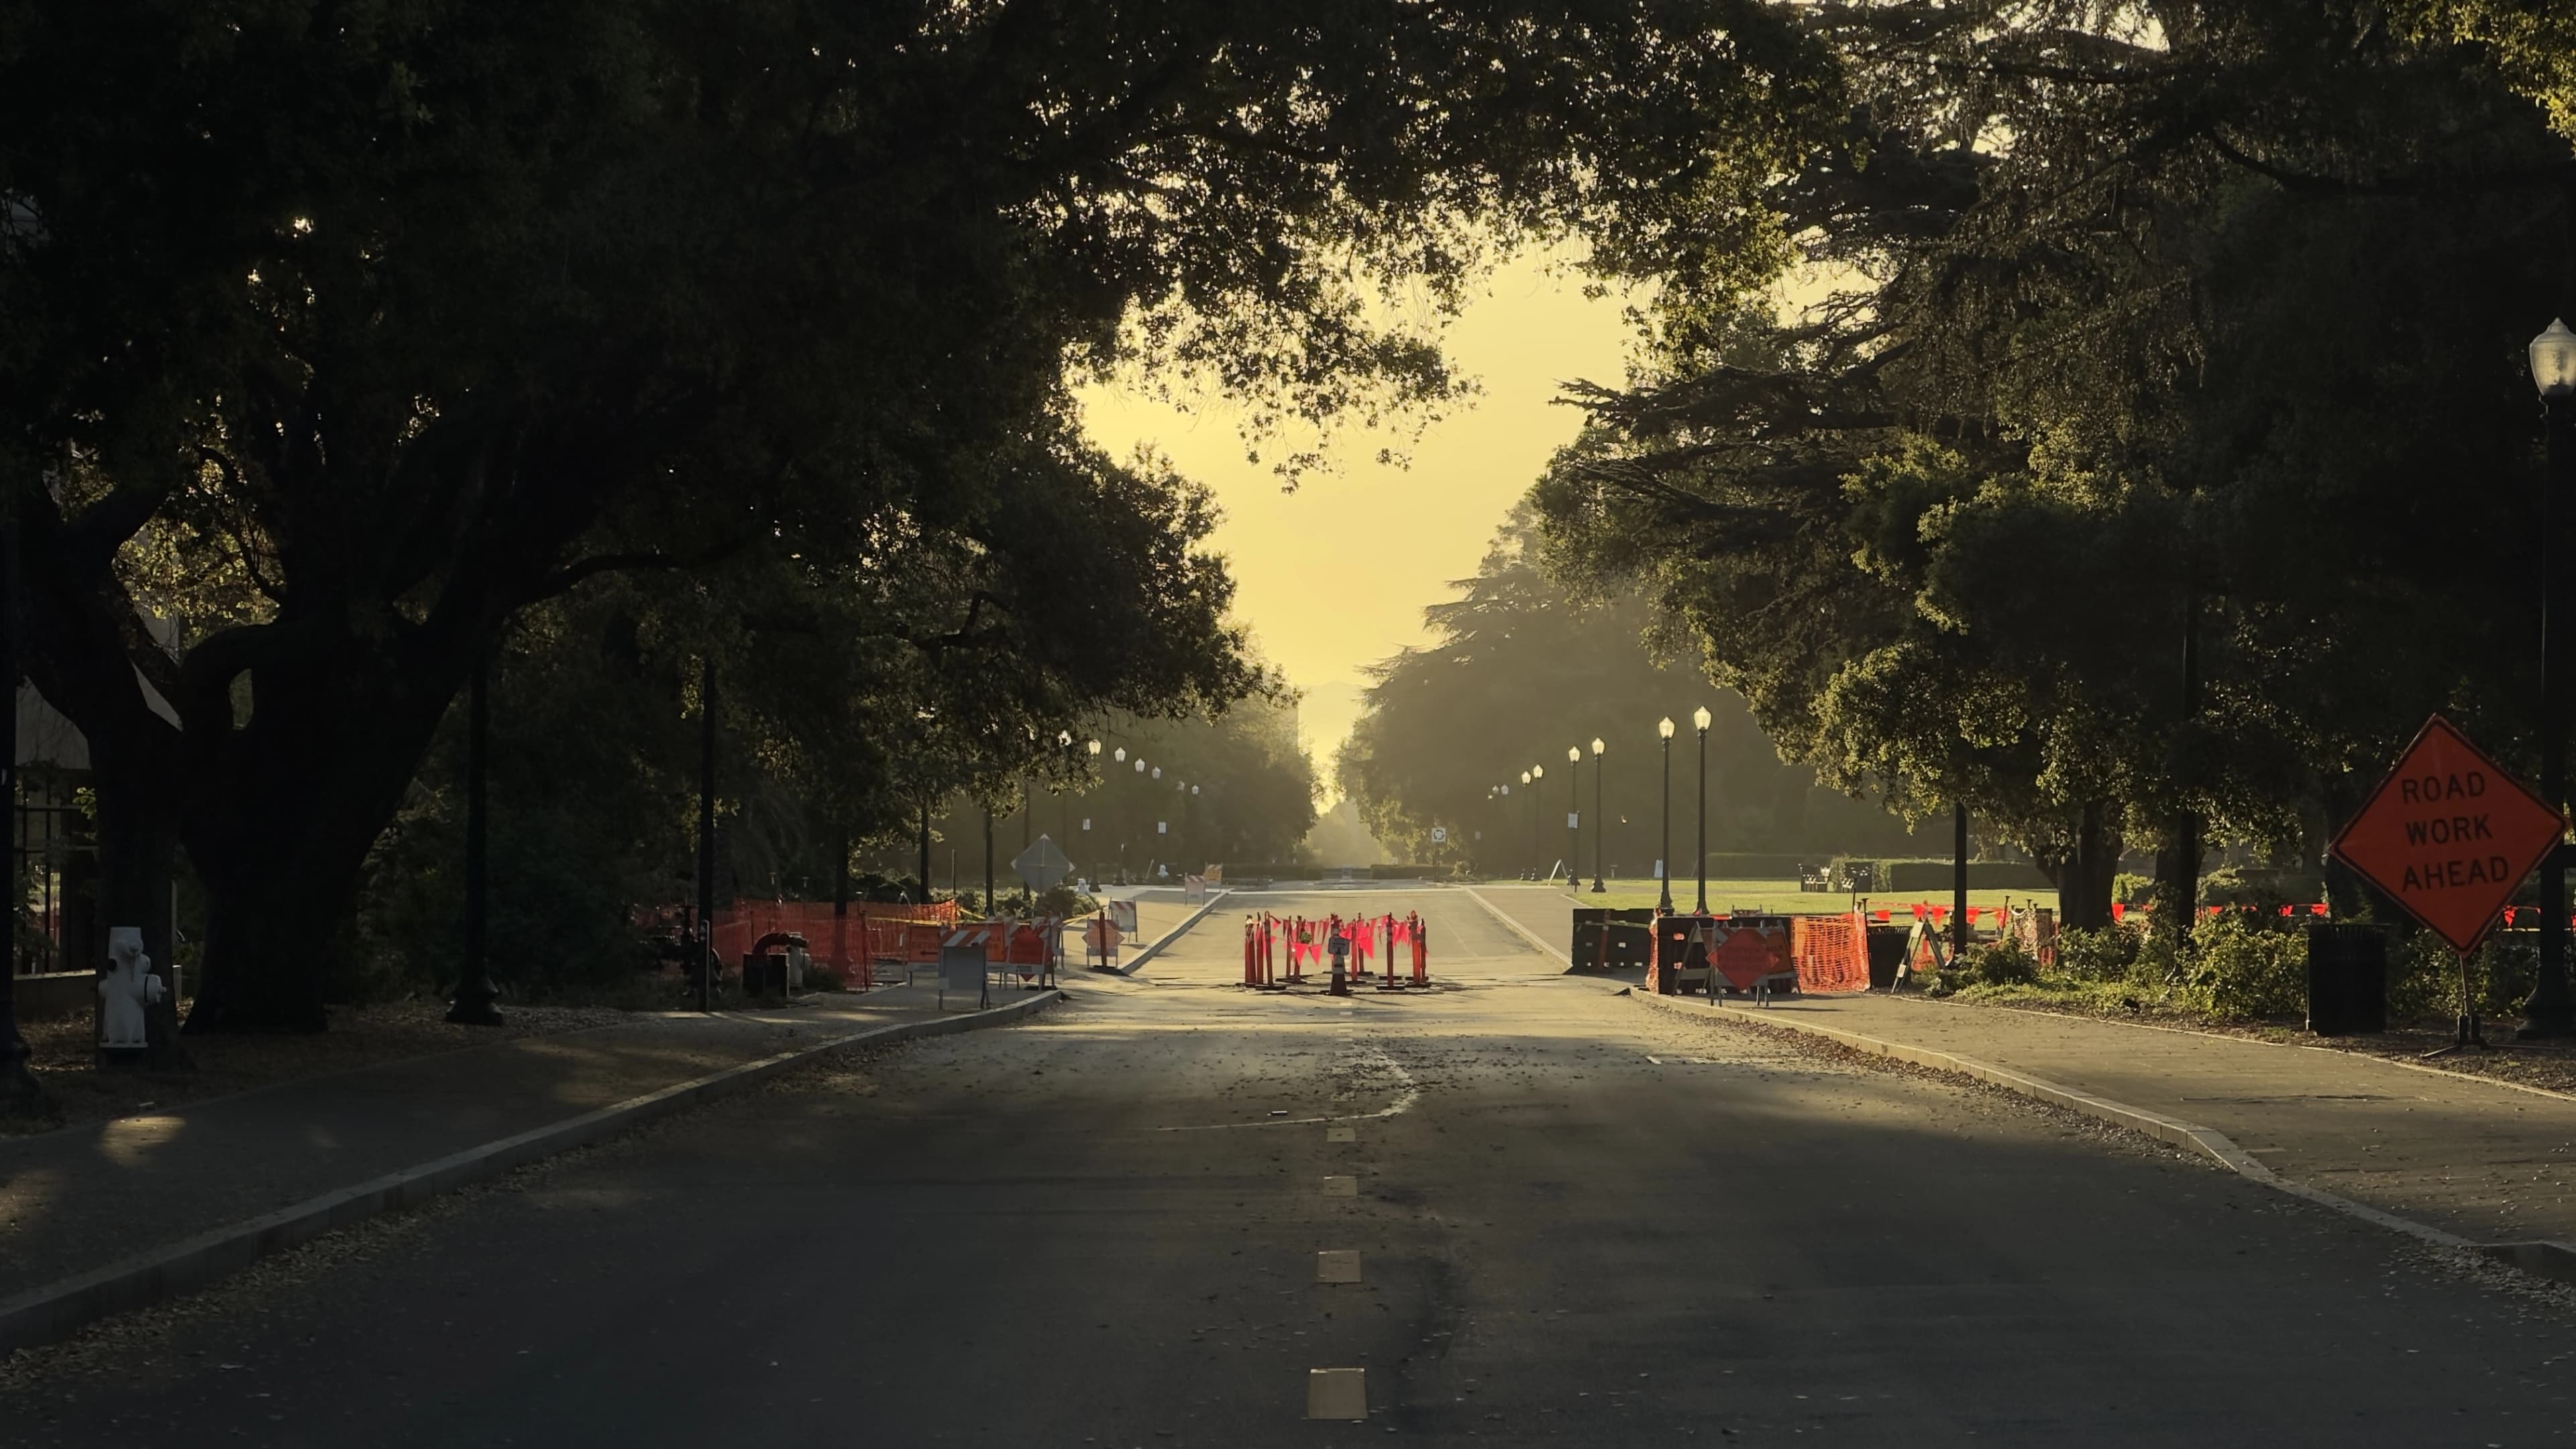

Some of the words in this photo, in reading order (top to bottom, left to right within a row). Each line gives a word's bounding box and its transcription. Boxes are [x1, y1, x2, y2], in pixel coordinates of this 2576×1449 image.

[2401, 772, 2485, 804] ROAD
[2406, 814, 2493, 847] WORK
[2402, 856, 2509, 892] AHEAD
